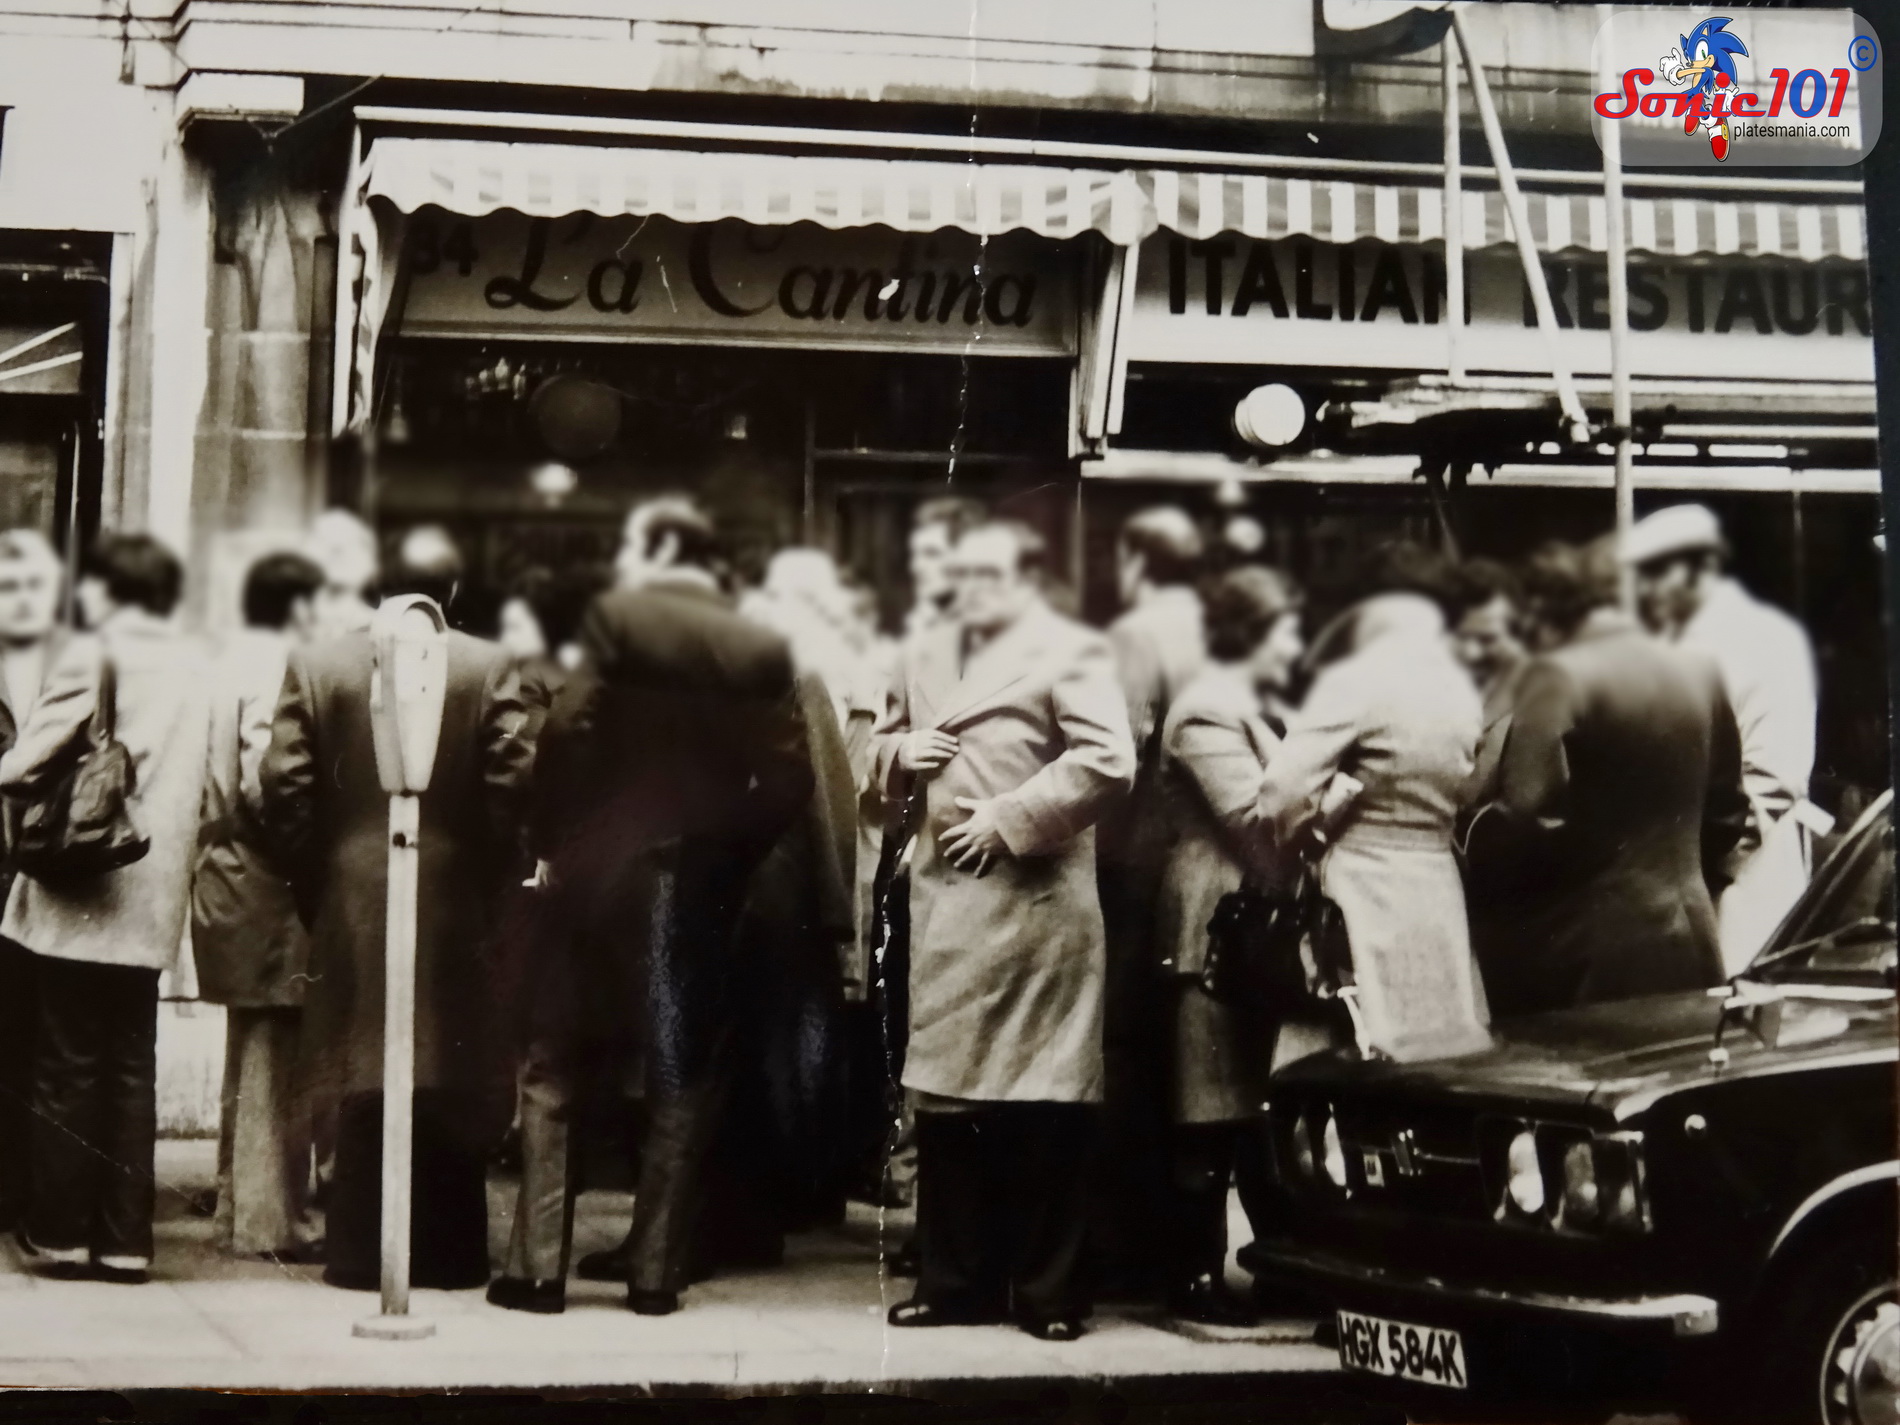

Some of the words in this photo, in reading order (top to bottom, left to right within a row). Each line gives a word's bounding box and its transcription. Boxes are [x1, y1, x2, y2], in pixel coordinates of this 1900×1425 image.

[688, 221, 1038, 328] Cantina
[1168, 237, 1471, 325] ITALIAN
[1339, 1315, 1385, 1369] HGX
[1387, 1324, 1464, 1385] 584K
